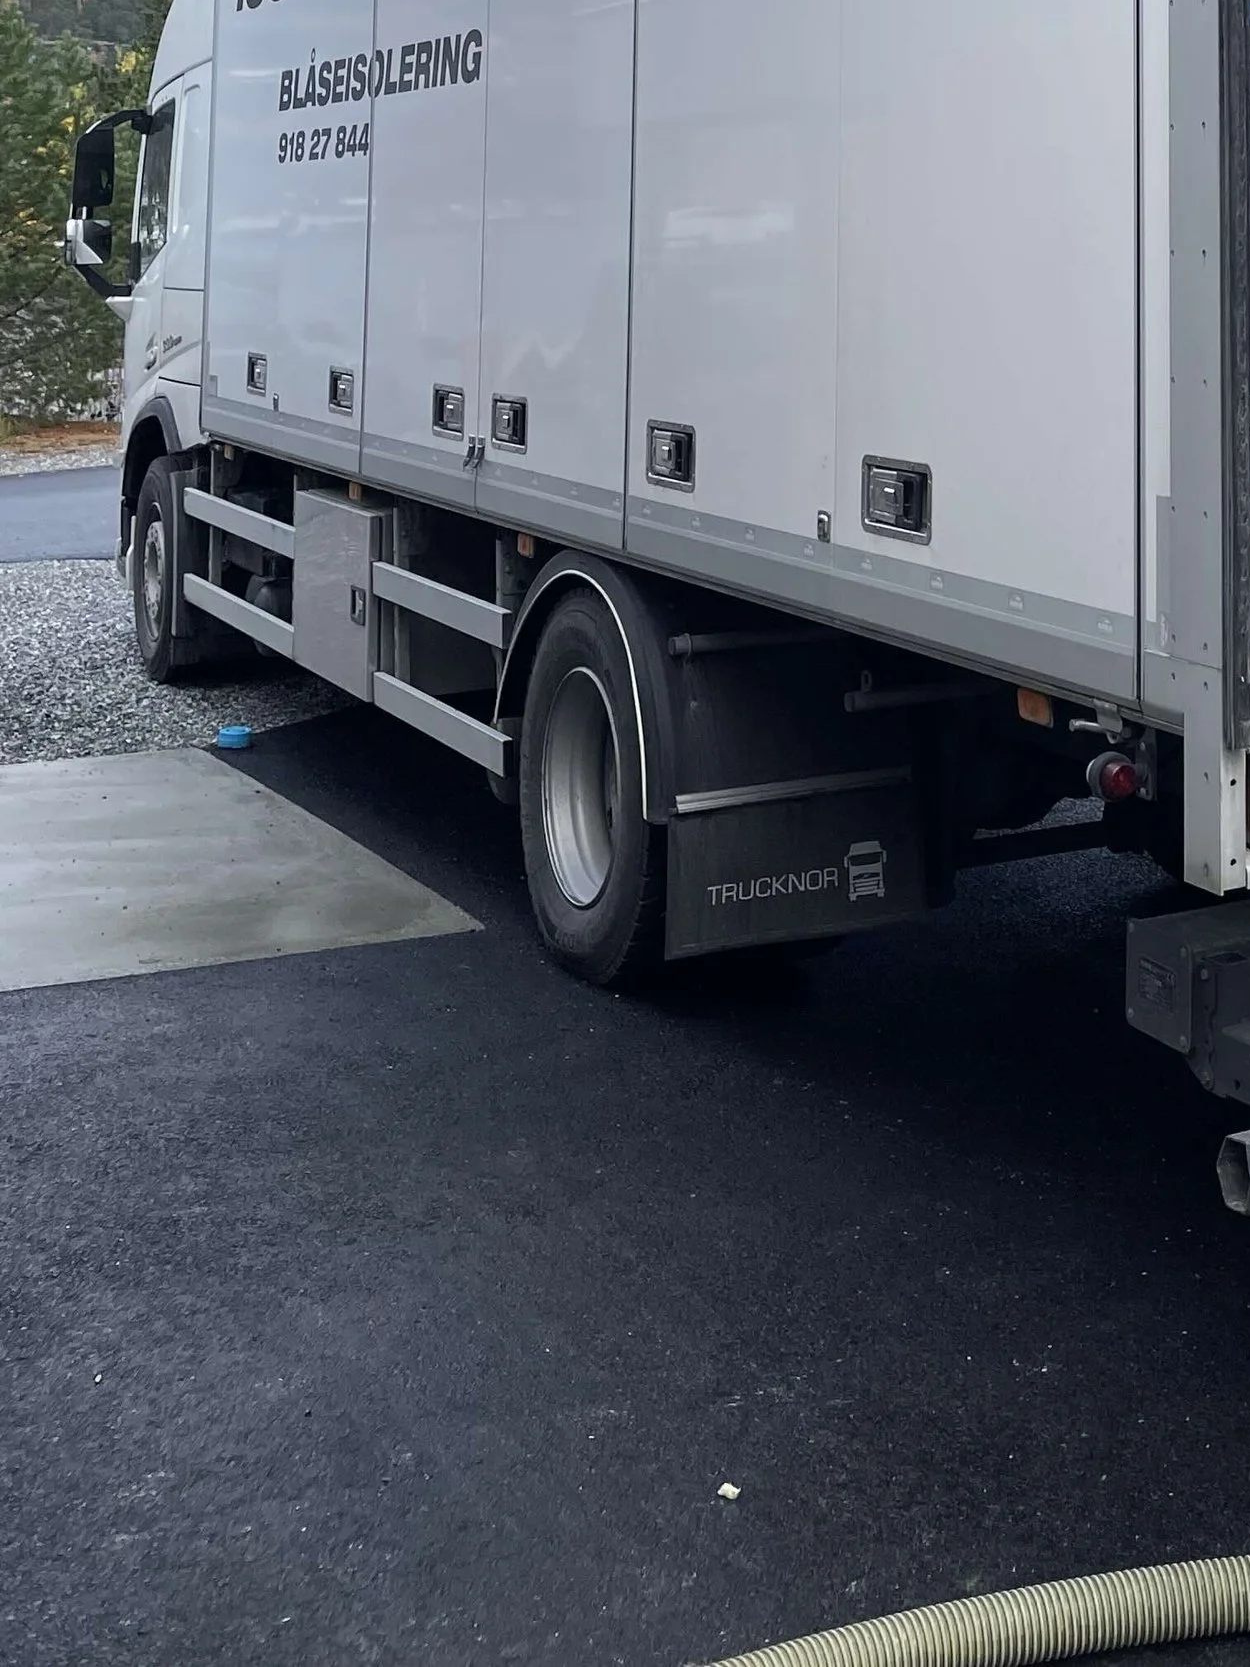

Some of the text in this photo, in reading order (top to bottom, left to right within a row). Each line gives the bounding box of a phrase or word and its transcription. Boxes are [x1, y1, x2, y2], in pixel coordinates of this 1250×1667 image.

[278, 29, 483, 111] BLÅSEISOLERING
[278, 123, 370, 163] 918 27 844
[707, 867, 839, 906] TRUCKNOR
